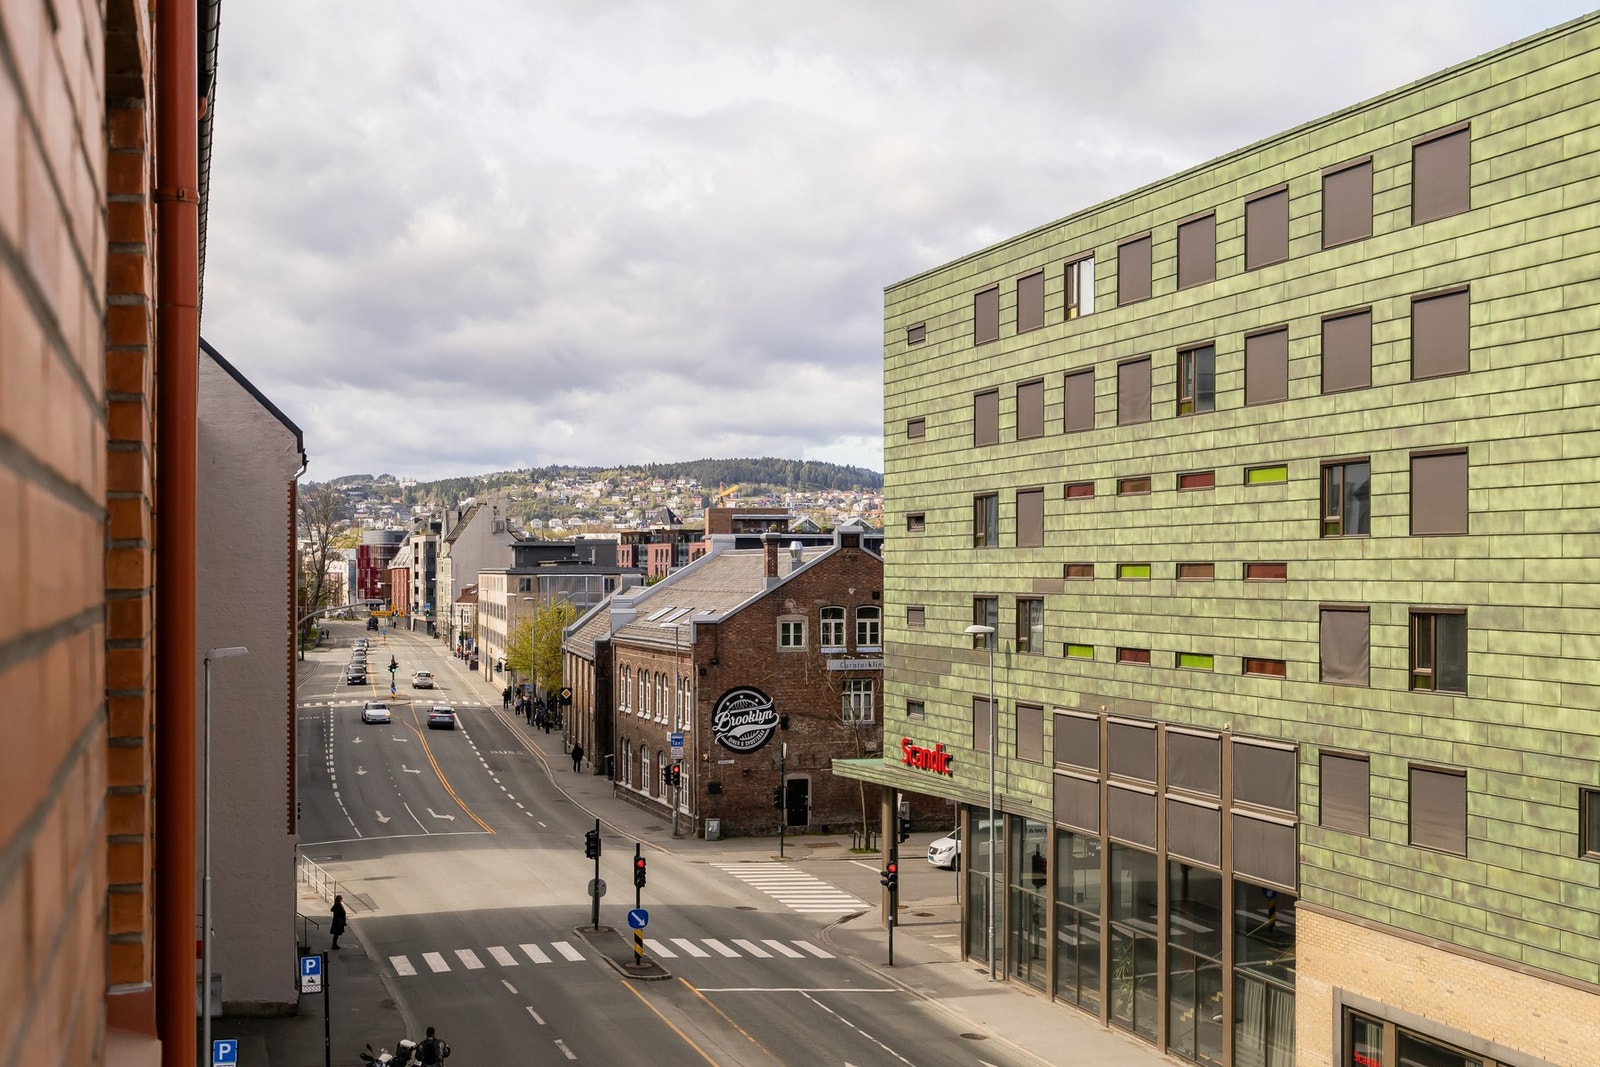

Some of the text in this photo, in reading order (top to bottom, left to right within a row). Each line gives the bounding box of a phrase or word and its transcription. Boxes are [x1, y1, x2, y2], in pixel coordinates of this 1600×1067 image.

[839, 660, 885, 669] Curatorklin
[712, 709, 774, 732] Brooklyn
[901, 737, 952, 776] Scandic
[305, 959, 316, 974] P
[219, 1043, 232, 1060] P
[1353, 1049, 1382, 1067] Scan
